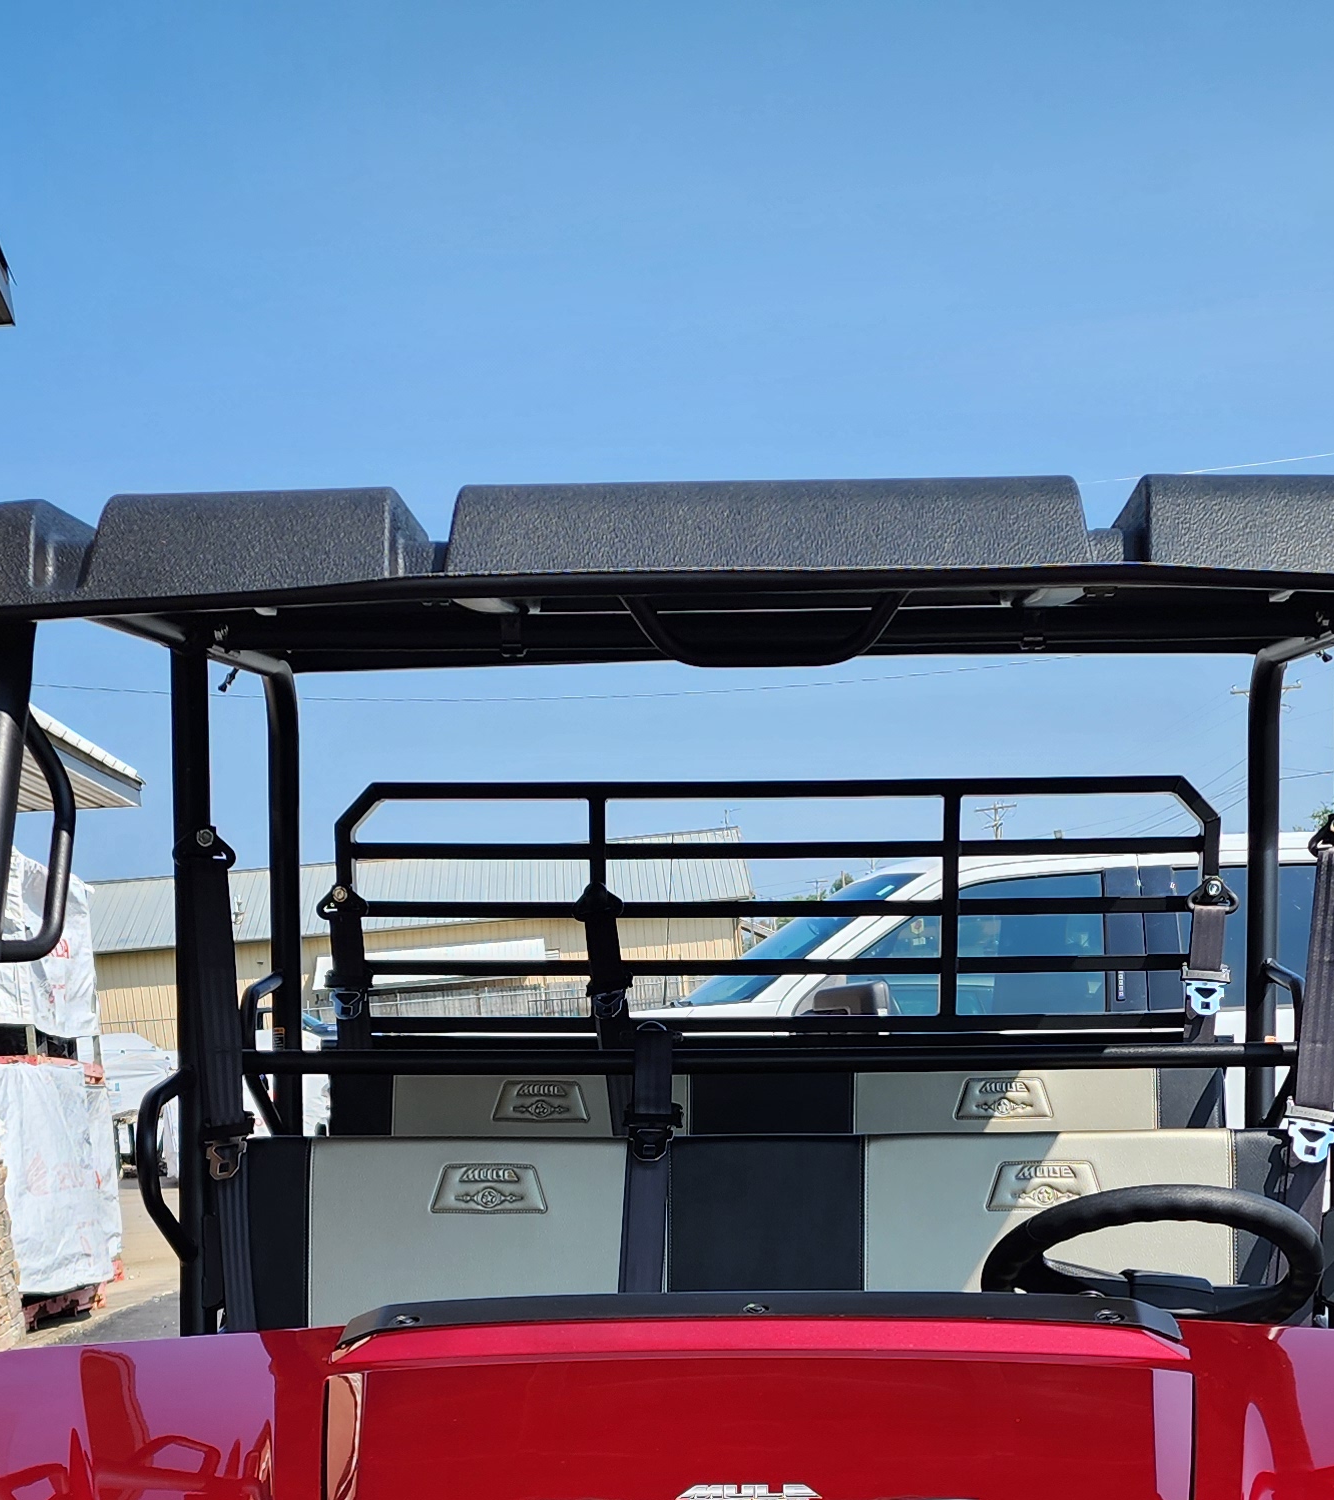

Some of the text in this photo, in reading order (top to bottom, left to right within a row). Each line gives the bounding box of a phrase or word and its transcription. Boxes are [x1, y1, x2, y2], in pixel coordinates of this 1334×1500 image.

[516, 1083, 567, 1096] MULE
[979, 1081, 1030, 1093] MULE
[459, 1167, 519, 1182] MULE
[1015, 1165, 1076, 1180] MULE
[675, 1484, 823, 1500] MULE
